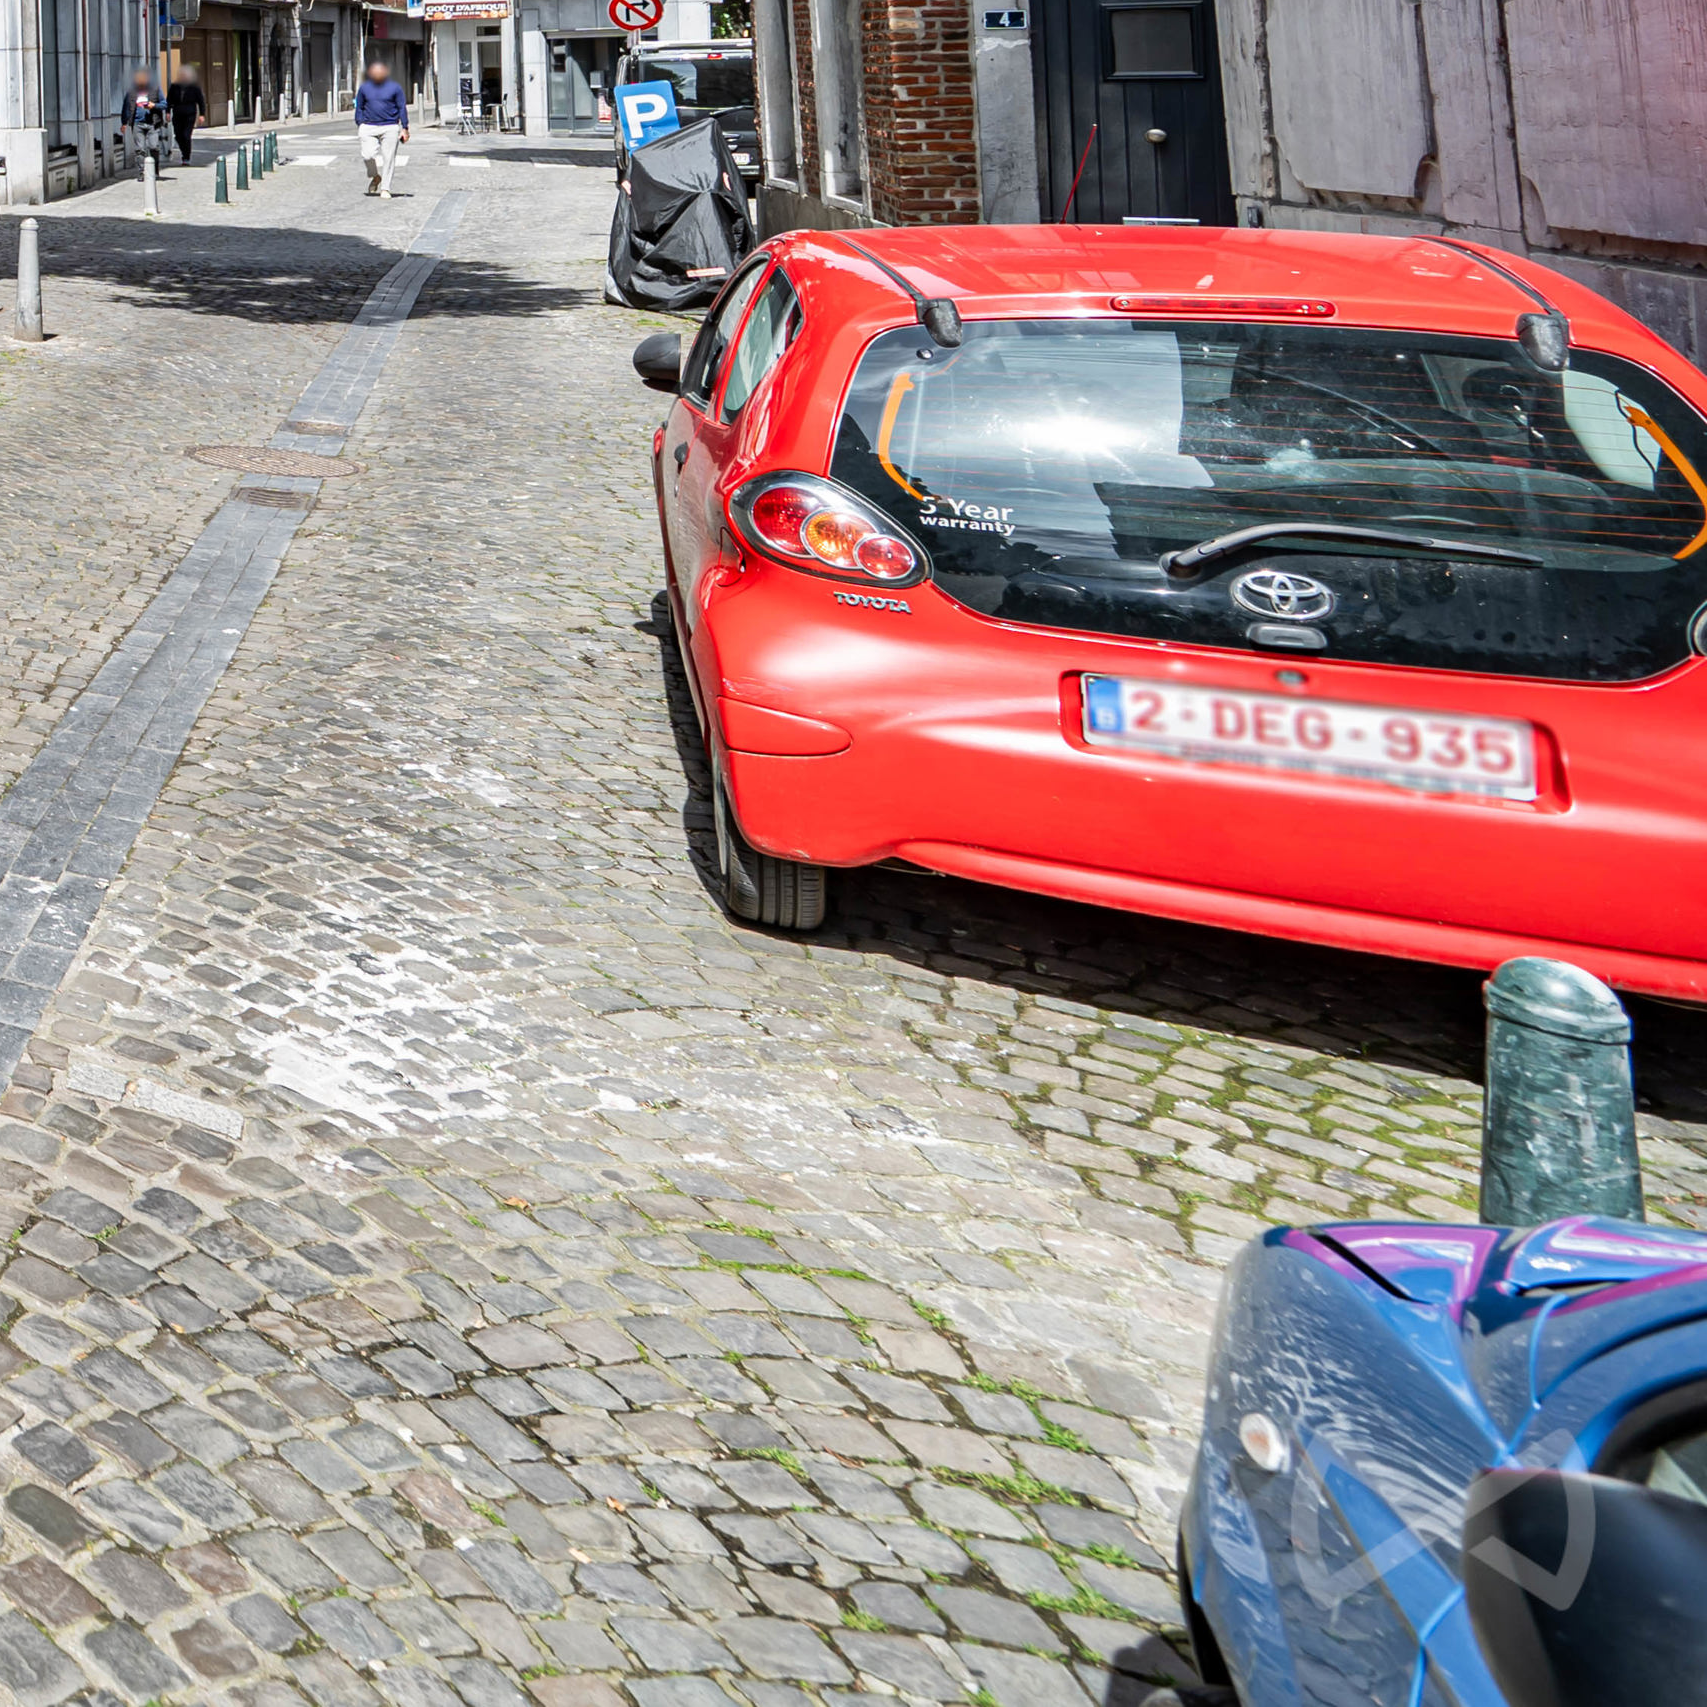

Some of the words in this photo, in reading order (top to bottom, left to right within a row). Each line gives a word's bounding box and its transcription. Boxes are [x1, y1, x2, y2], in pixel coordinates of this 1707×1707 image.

[998, 12, 1011, 27] 4
[622, 93, 668, 140] P
[919, 496, 937, 515] 5
[947, 498, 1014, 522] Year
[919, 515, 1016, 536] warranty
[833, 591, 912, 615] TOYOTA
